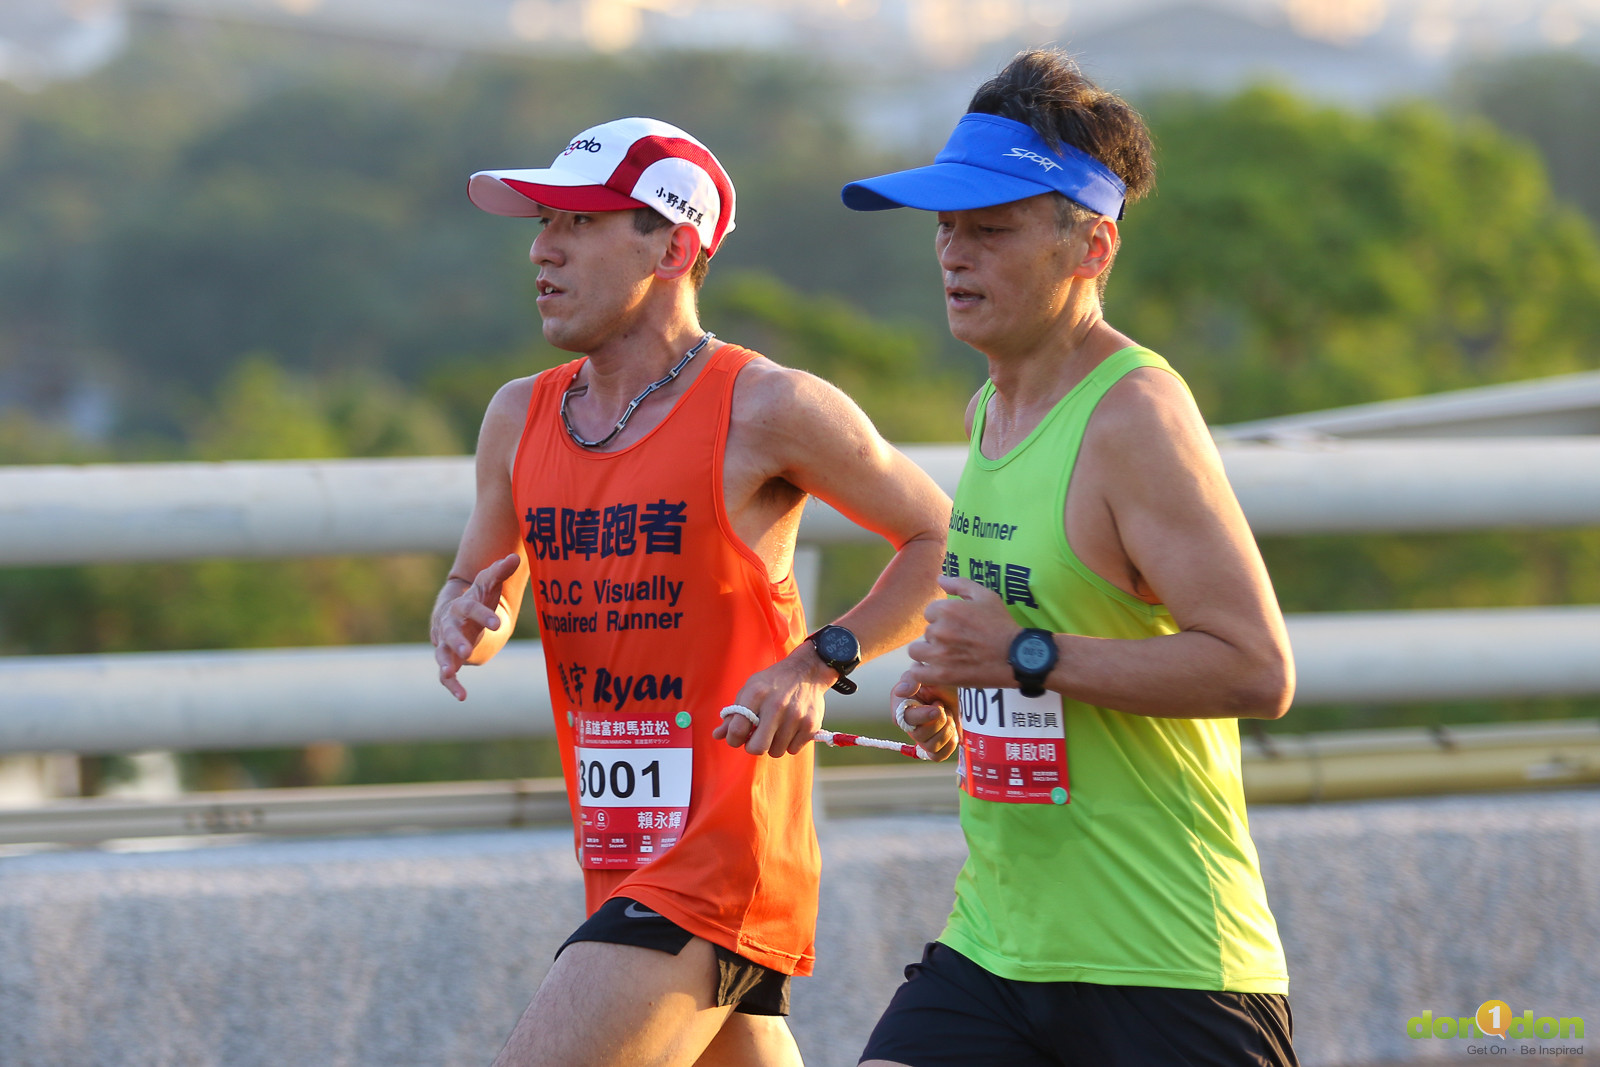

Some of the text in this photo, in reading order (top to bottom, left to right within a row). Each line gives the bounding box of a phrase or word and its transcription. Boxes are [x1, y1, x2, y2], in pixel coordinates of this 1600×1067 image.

[1002, 147, 1063, 172] SPORT
[525, 499, 687, 561] 視障跑者
[949, 508, 1018, 541] uide Runner
[593, 575, 683, 607] Visually
[606, 610, 684, 632] Runner
[593, 668, 683, 712] Ryan
[585, 720, 670, 736] 高雄富邦馬拉松
[1012, 712, 1059, 728] 陪跑員
[597, 812, 605, 822] G
[637, 811, 682, 830] 賴永輝
